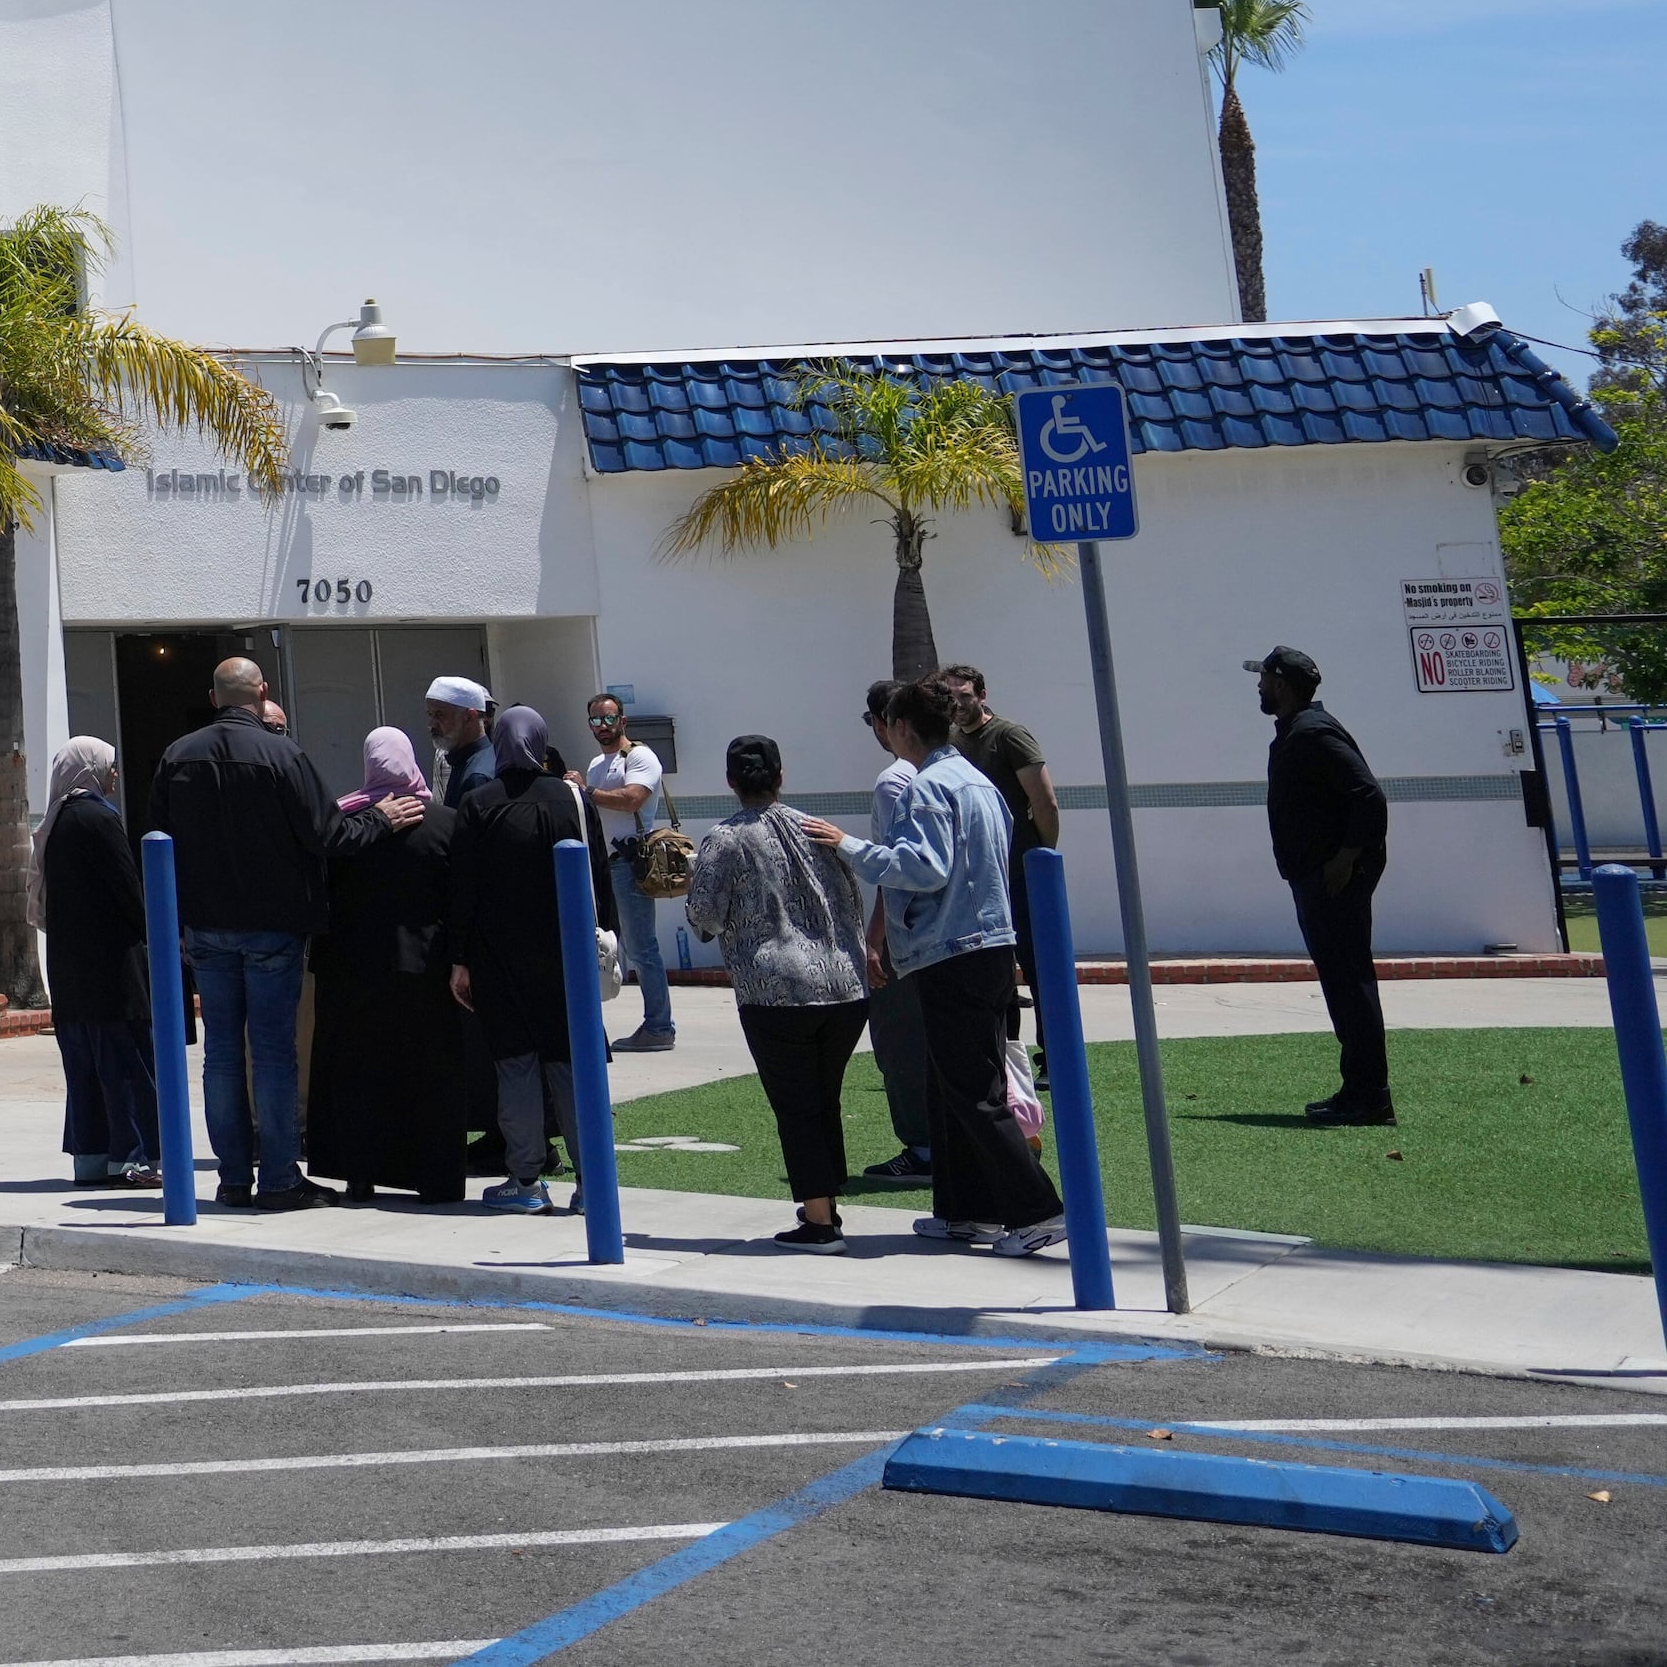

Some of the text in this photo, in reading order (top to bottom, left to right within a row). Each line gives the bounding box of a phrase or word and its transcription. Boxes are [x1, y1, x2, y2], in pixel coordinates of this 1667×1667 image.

[147, 468, 501, 500] Islamic Cnter of San Diego
[1028, 465, 1128, 499] PARKING
[1051, 501, 1111, 533] ONLY
[296, 578, 373, 604] 7050
[1405, 582, 1472, 594] No smoking on
[1440, 596, 1473, 608] property
[1445, 649, 1502, 659] SKATEBOARDING
[1420, 651, 1445, 686] NO
[1446, 658, 1505, 668] BICYCLE RIDING
[1448, 667, 1507, 677] ROLLER BLADING
[1449, 676, 1508, 686] SCOOTER RIDING
